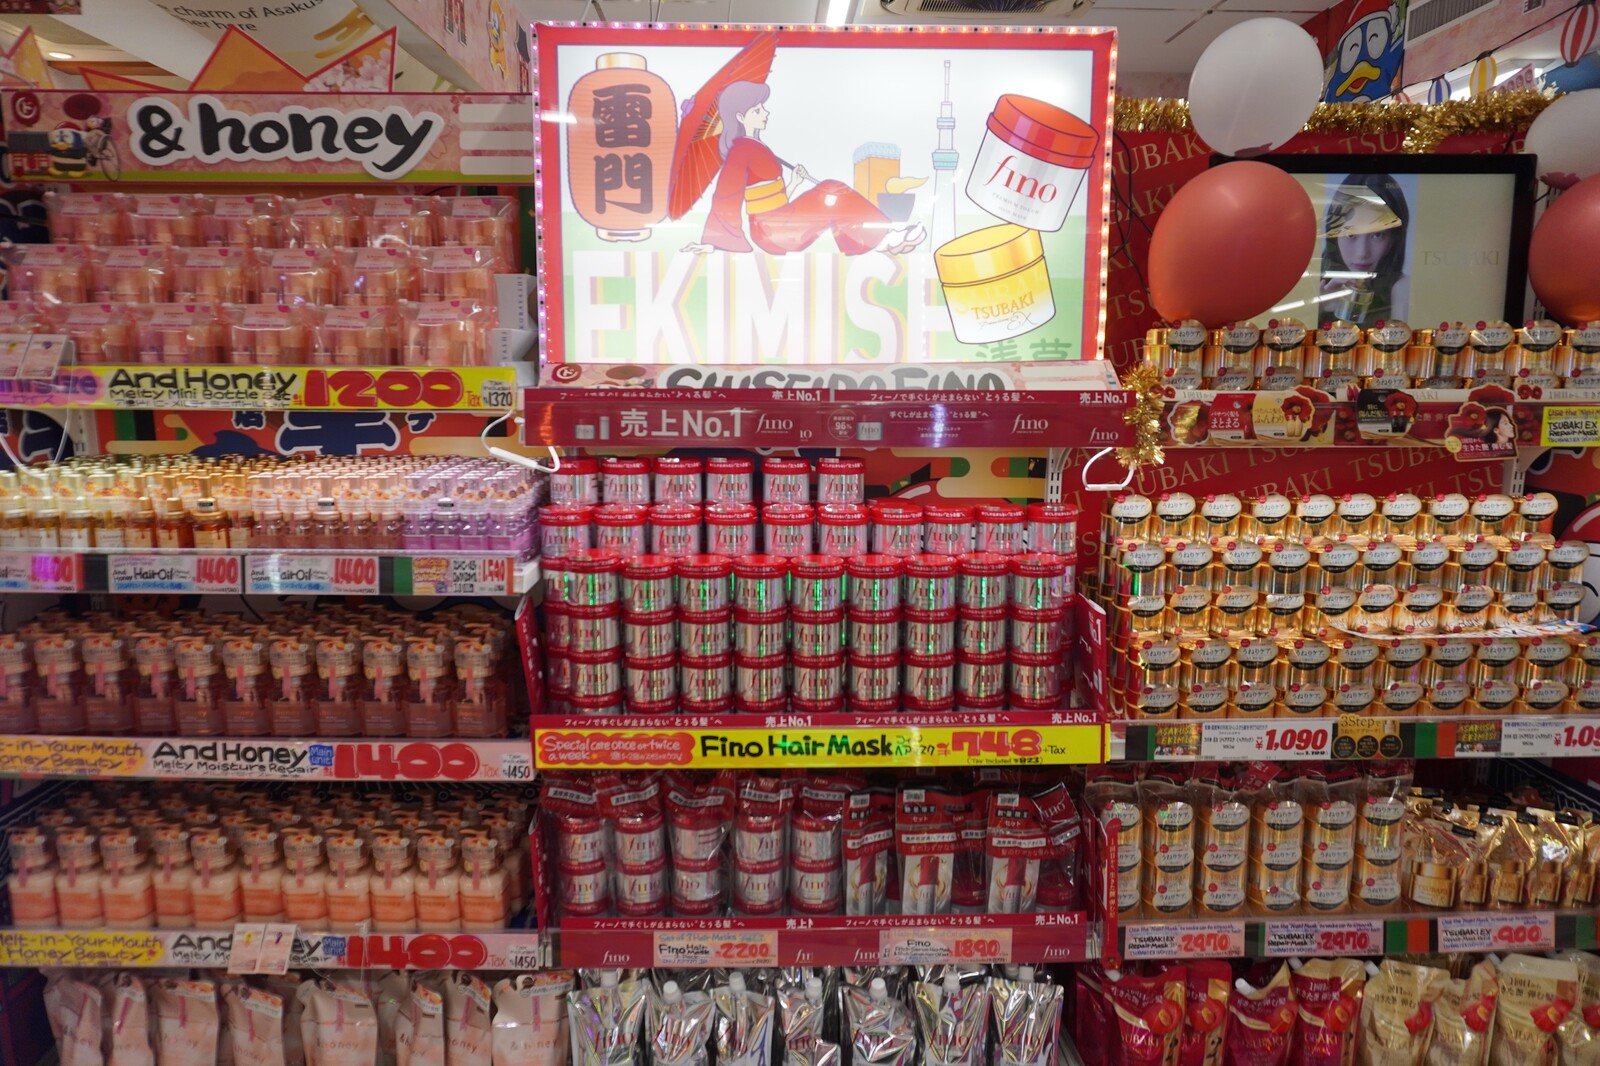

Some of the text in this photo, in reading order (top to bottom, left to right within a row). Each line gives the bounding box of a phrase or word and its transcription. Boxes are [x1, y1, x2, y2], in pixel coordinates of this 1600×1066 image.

[173, 5, 235, 19] charm
[238, 7, 259, 19] of
[200, 102, 433, 173] honey
[592, 83, 654, 214] 雷門
[982, 155, 1058, 204] fino
[970, 291, 1035, 320] TSUBAKI
[109, 368, 297, 396] And Honey
[110, 389, 164, 399] Melty
[168, 388, 197, 399] Mini
[203, 388, 258, 399] Bottle
[620, 408, 742, 438] 売上No.1
[755, 413, 794, 434] fino
[1009, 412, 1049, 434] fino
[1211, 418, 1240, 429] まとまる
[1548, 421, 1598, 430] TSUBAKI EX
[1088, 426, 1119, 443] fino
[134, 567, 173, 581] Hair Oil
[765, 716, 812, 727] 売上No.1
[1051, 712, 1097, 724] 売上No.1
[543, 736, 590, 752] Special
[649, 738, 681, 751] twice
[701, 735, 763, 757] Fino
[768, 734, 825, 757] Hair
[826, 734, 893, 757] Mask
[952, 730, 1042, 758] 748
[1265, 728, 1328, 751] 1,090
[152, 742, 308, 768] And Honey
[311, 746, 332, 756] Main
[559, 750, 591, 760] week
[50, 752, 123, 770] Beauty
[153, 760, 193, 771] Melty
[197, 760, 266, 771] Moisture
[269, 762, 319, 774] Repair
[334, 742, 480, 780] 1400
[1035, 913, 1079, 926] 売上No.1
[1320, 931, 1369, 951] 2970
[1442, 928, 1479, 937] TSUBAKI
[1497, 924, 1542, 943] 900
[347, 934, 488, 969] 1400
[658, 944, 686, 955] Fino
[719, 942, 769, 960] 2200
[907, 939, 931, 947] Fino
[954, 938, 1000, 957] 1890
[1042, 944, 1070, 959] fino
[1181, 933, 1230, 952] 2970
[7, 947, 144, 962] Honey Beauty
